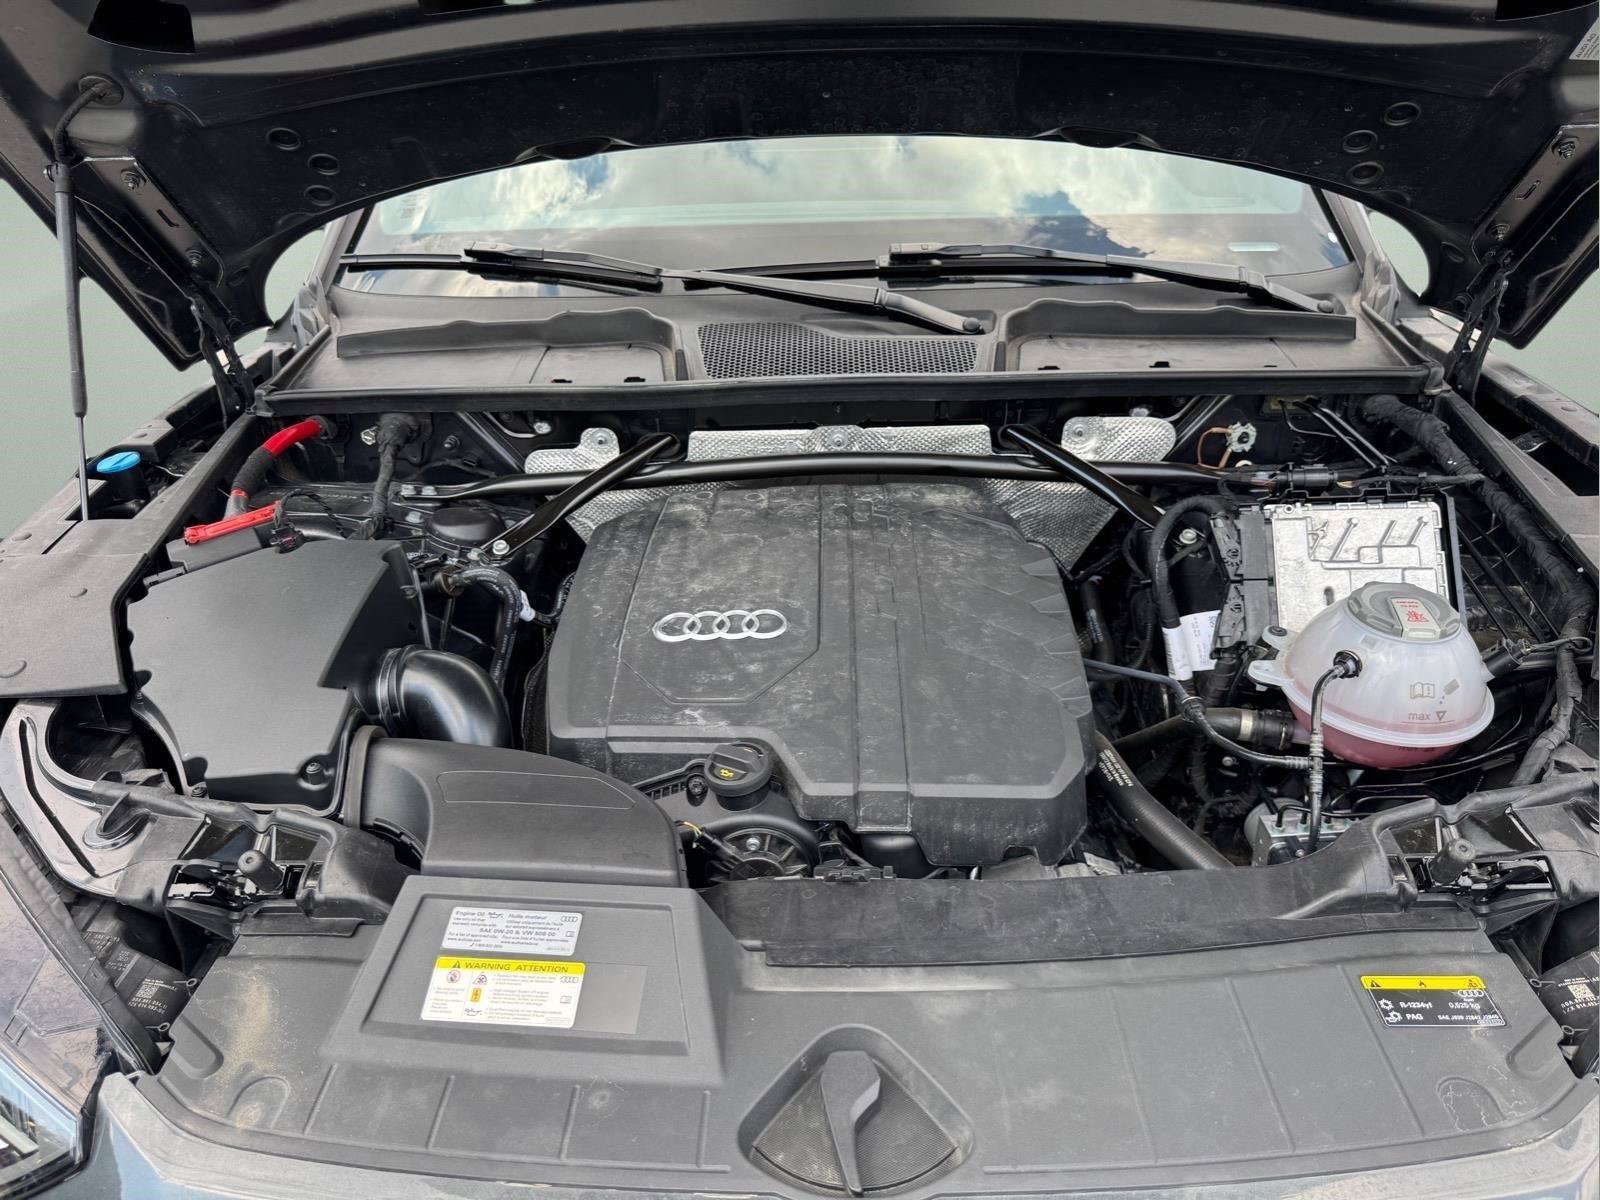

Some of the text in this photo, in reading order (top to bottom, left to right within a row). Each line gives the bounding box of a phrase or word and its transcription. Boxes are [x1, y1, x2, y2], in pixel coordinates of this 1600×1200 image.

[1408, 711, 1431, 721] max
[465, 961, 569, 973] WARNING ATTENTION
[1399, 1002, 1433, 1010] R-1234yf
[1405, 1013, 1424, 1021] PAG
